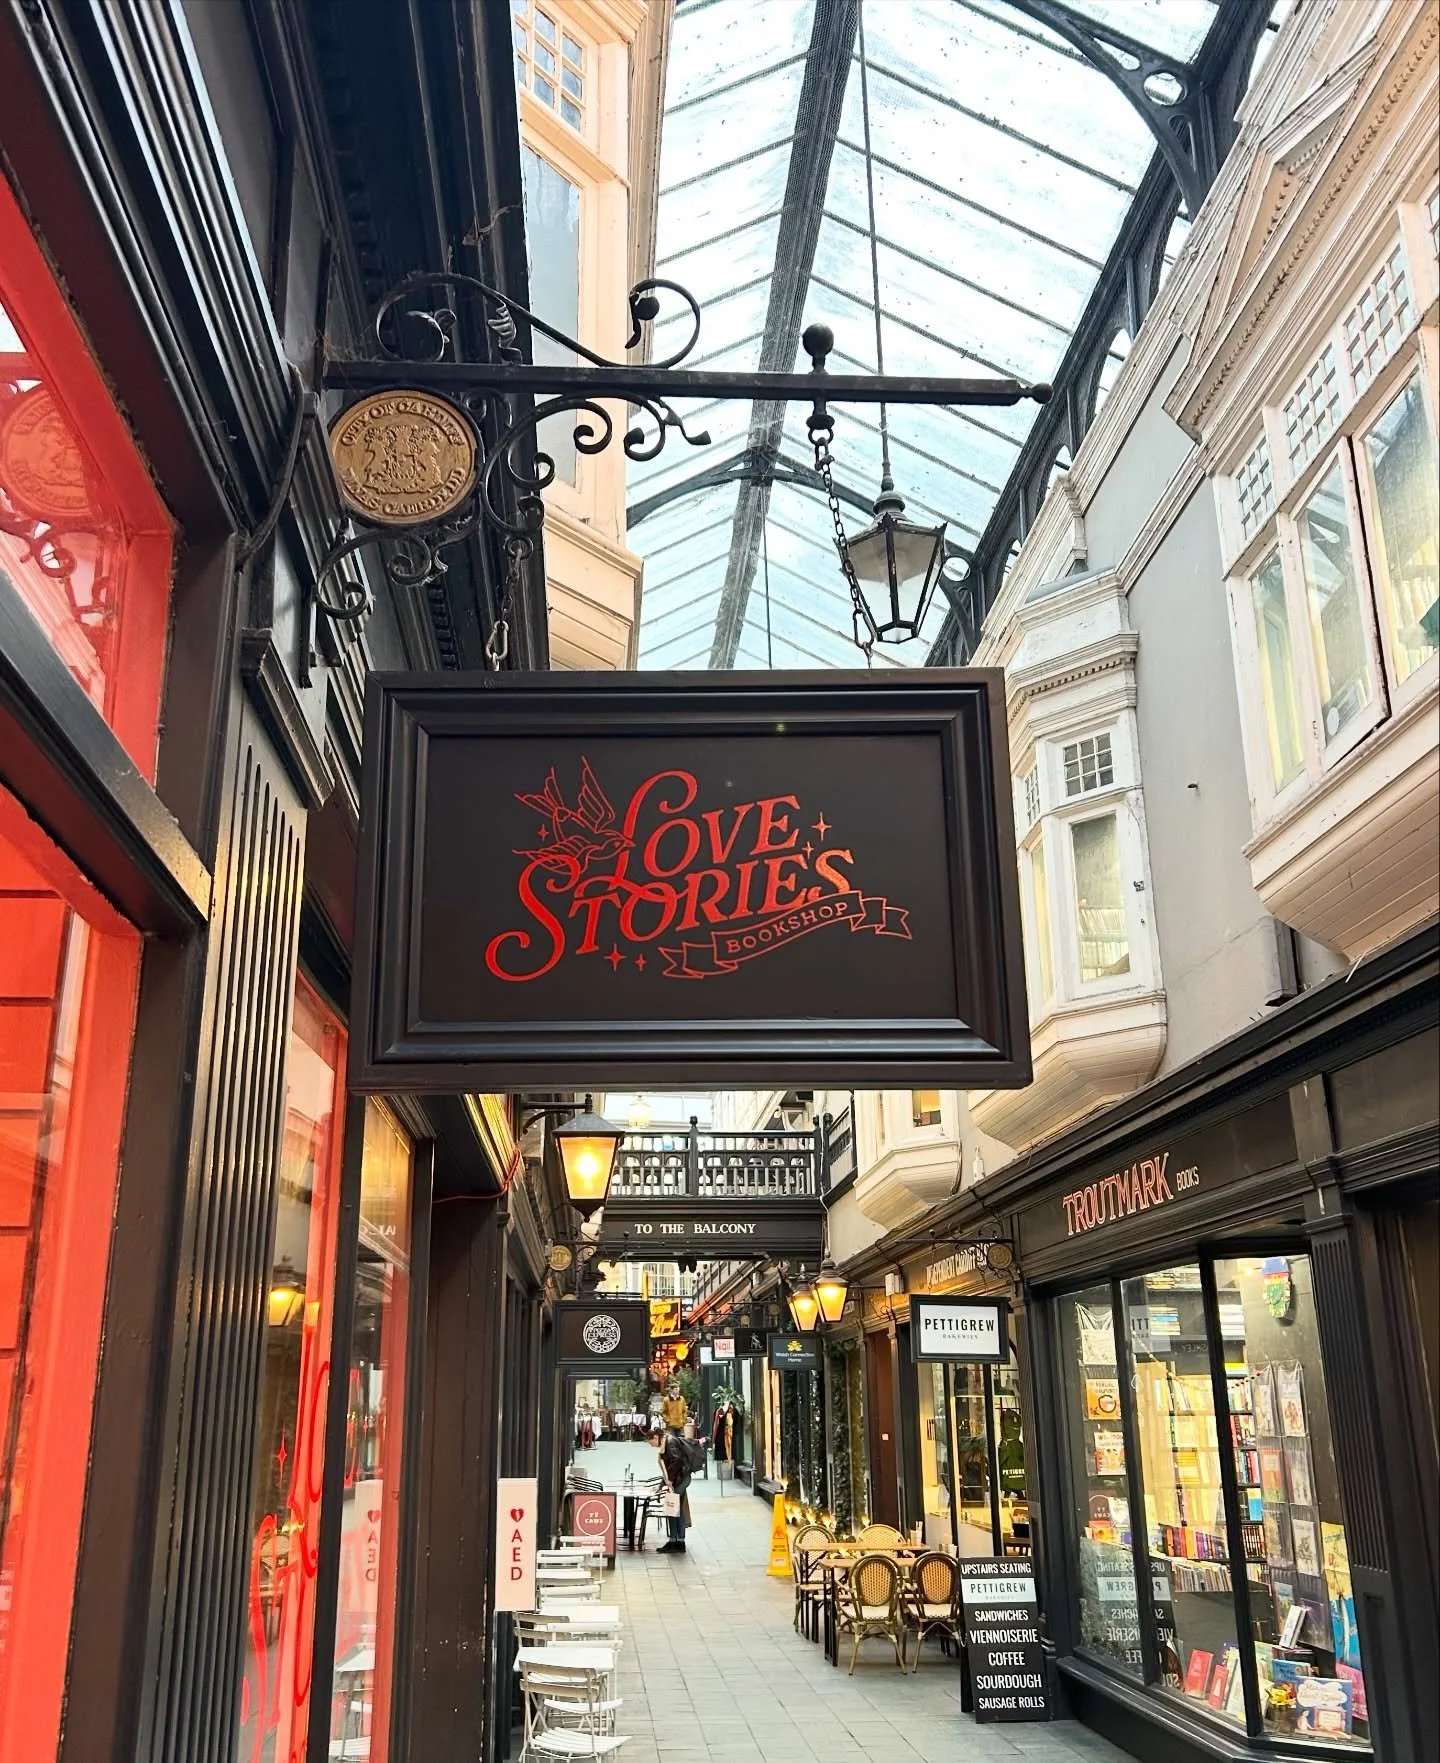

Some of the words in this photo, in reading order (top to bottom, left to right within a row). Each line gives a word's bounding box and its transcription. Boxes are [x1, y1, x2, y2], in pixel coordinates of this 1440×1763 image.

[341, 411, 372, 446] CITY
[369, 400, 394, 419] OF
[610, 769, 801, 888] LOVE
[485, 849, 855, 982] STORIES
[725, 901, 849, 953] BOOKSHOP
[1062, 1152, 1174, 1236] TROUTMARK
[1176, 1165, 1200, 1192] BOOKS
[634, 1223, 653, 1234] TO
[660, 1223, 685, 1234] THE
[693, 1223, 757, 1234] BALCONY
[924, 1318, 994, 1332] PETTIGREW
[509, 1528, 523, 1581] AED
[960, 1563, 998, 1575] UPSTAIRS
[999, 1562, 1032, 1574] SEATING
[970, 1582, 1026, 1594] PETTIGREW
[974, 1609, 1029, 1622] SANDWICHES
[969, 1628, 1039, 1644] VIENNOISERIE
[988, 1651, 1026, 1666] COFFEE
[976, 1673, 1042, 1690] SOURDOUGH
[978, 1696, 1018, 1709] SAUSAGE
[1018, 1696, 1045, 1708] ROLLS
